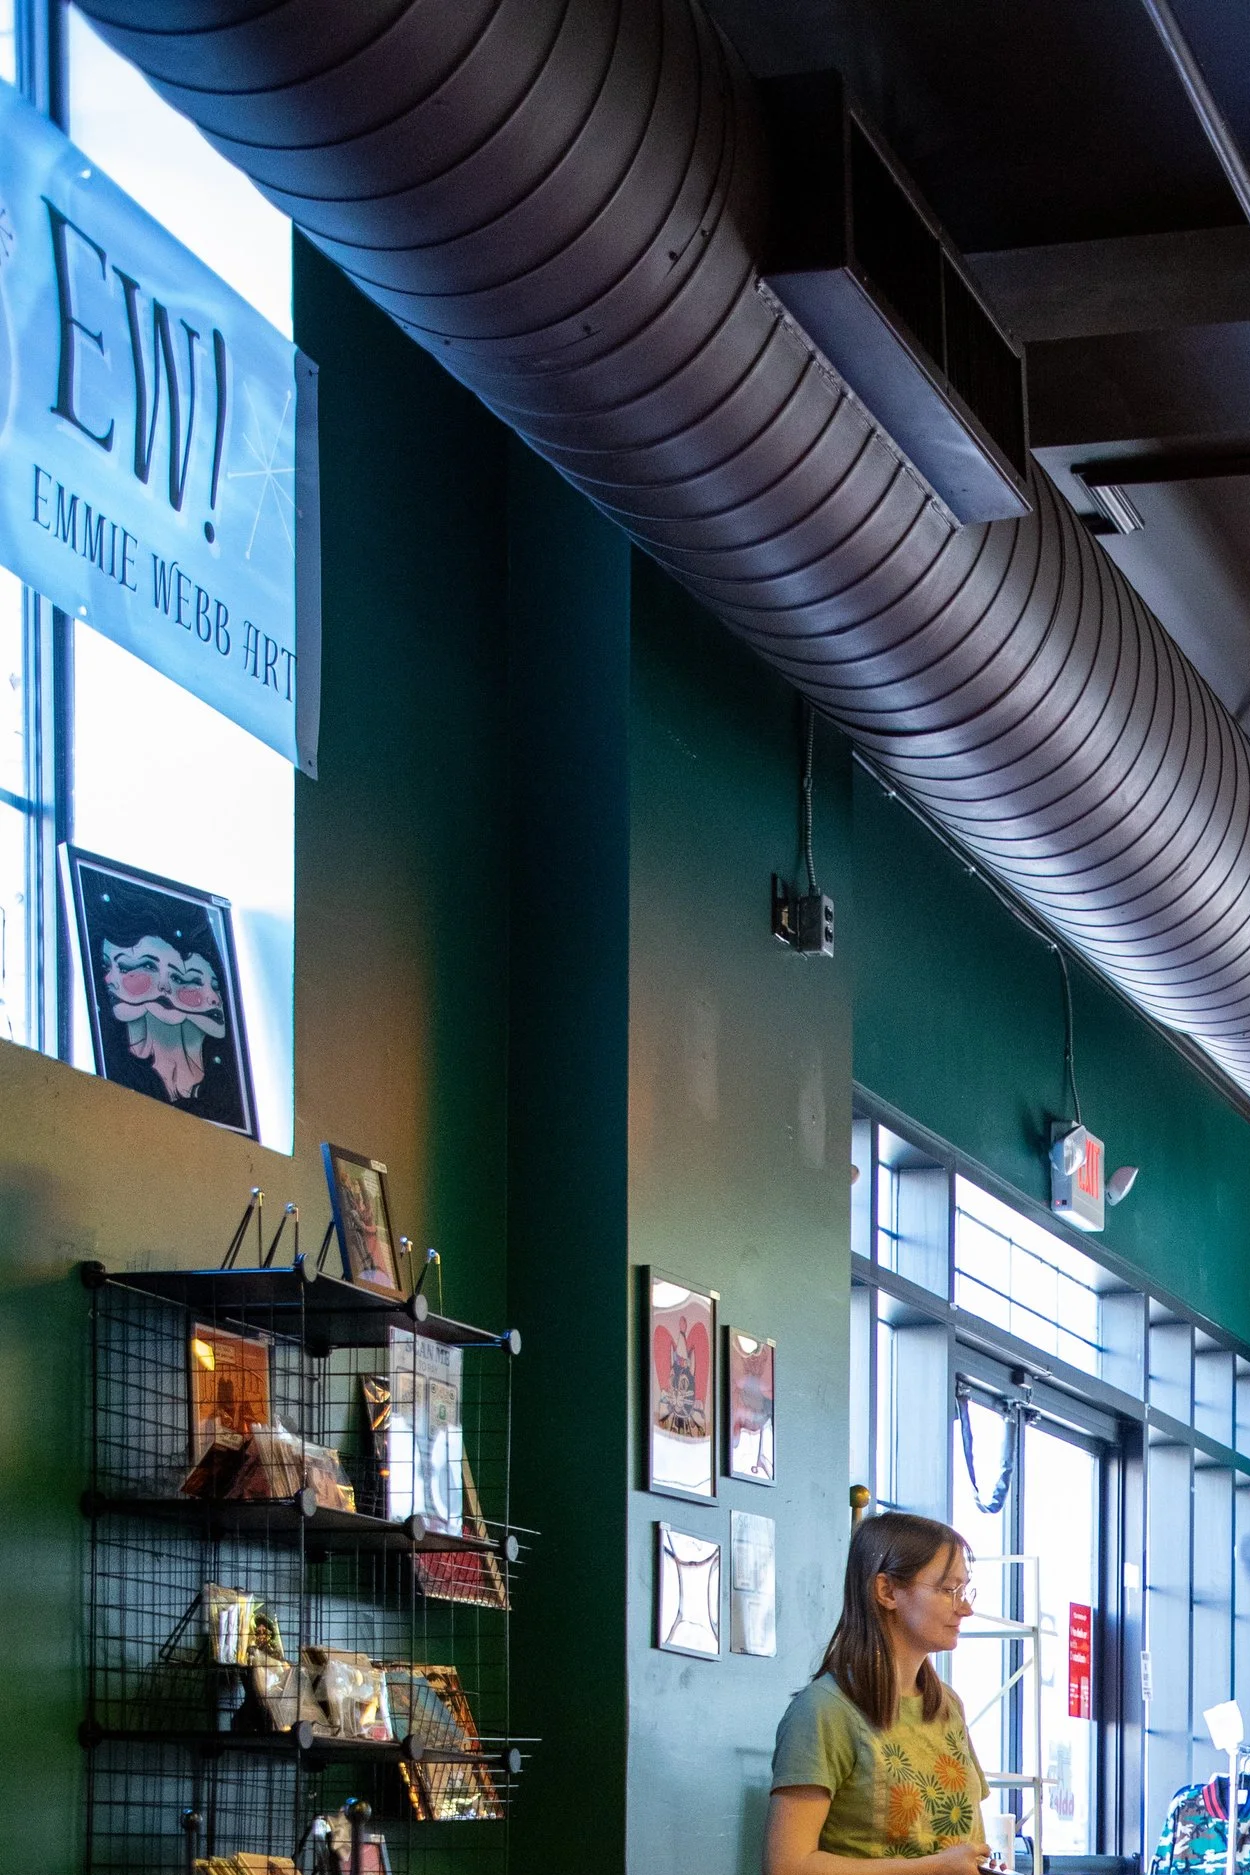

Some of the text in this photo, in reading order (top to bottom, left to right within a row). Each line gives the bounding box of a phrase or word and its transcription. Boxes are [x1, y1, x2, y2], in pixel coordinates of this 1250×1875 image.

[40, 195, 229, 544] EW!
[33, 464, 299, 703] EMMIE WEBB ART
